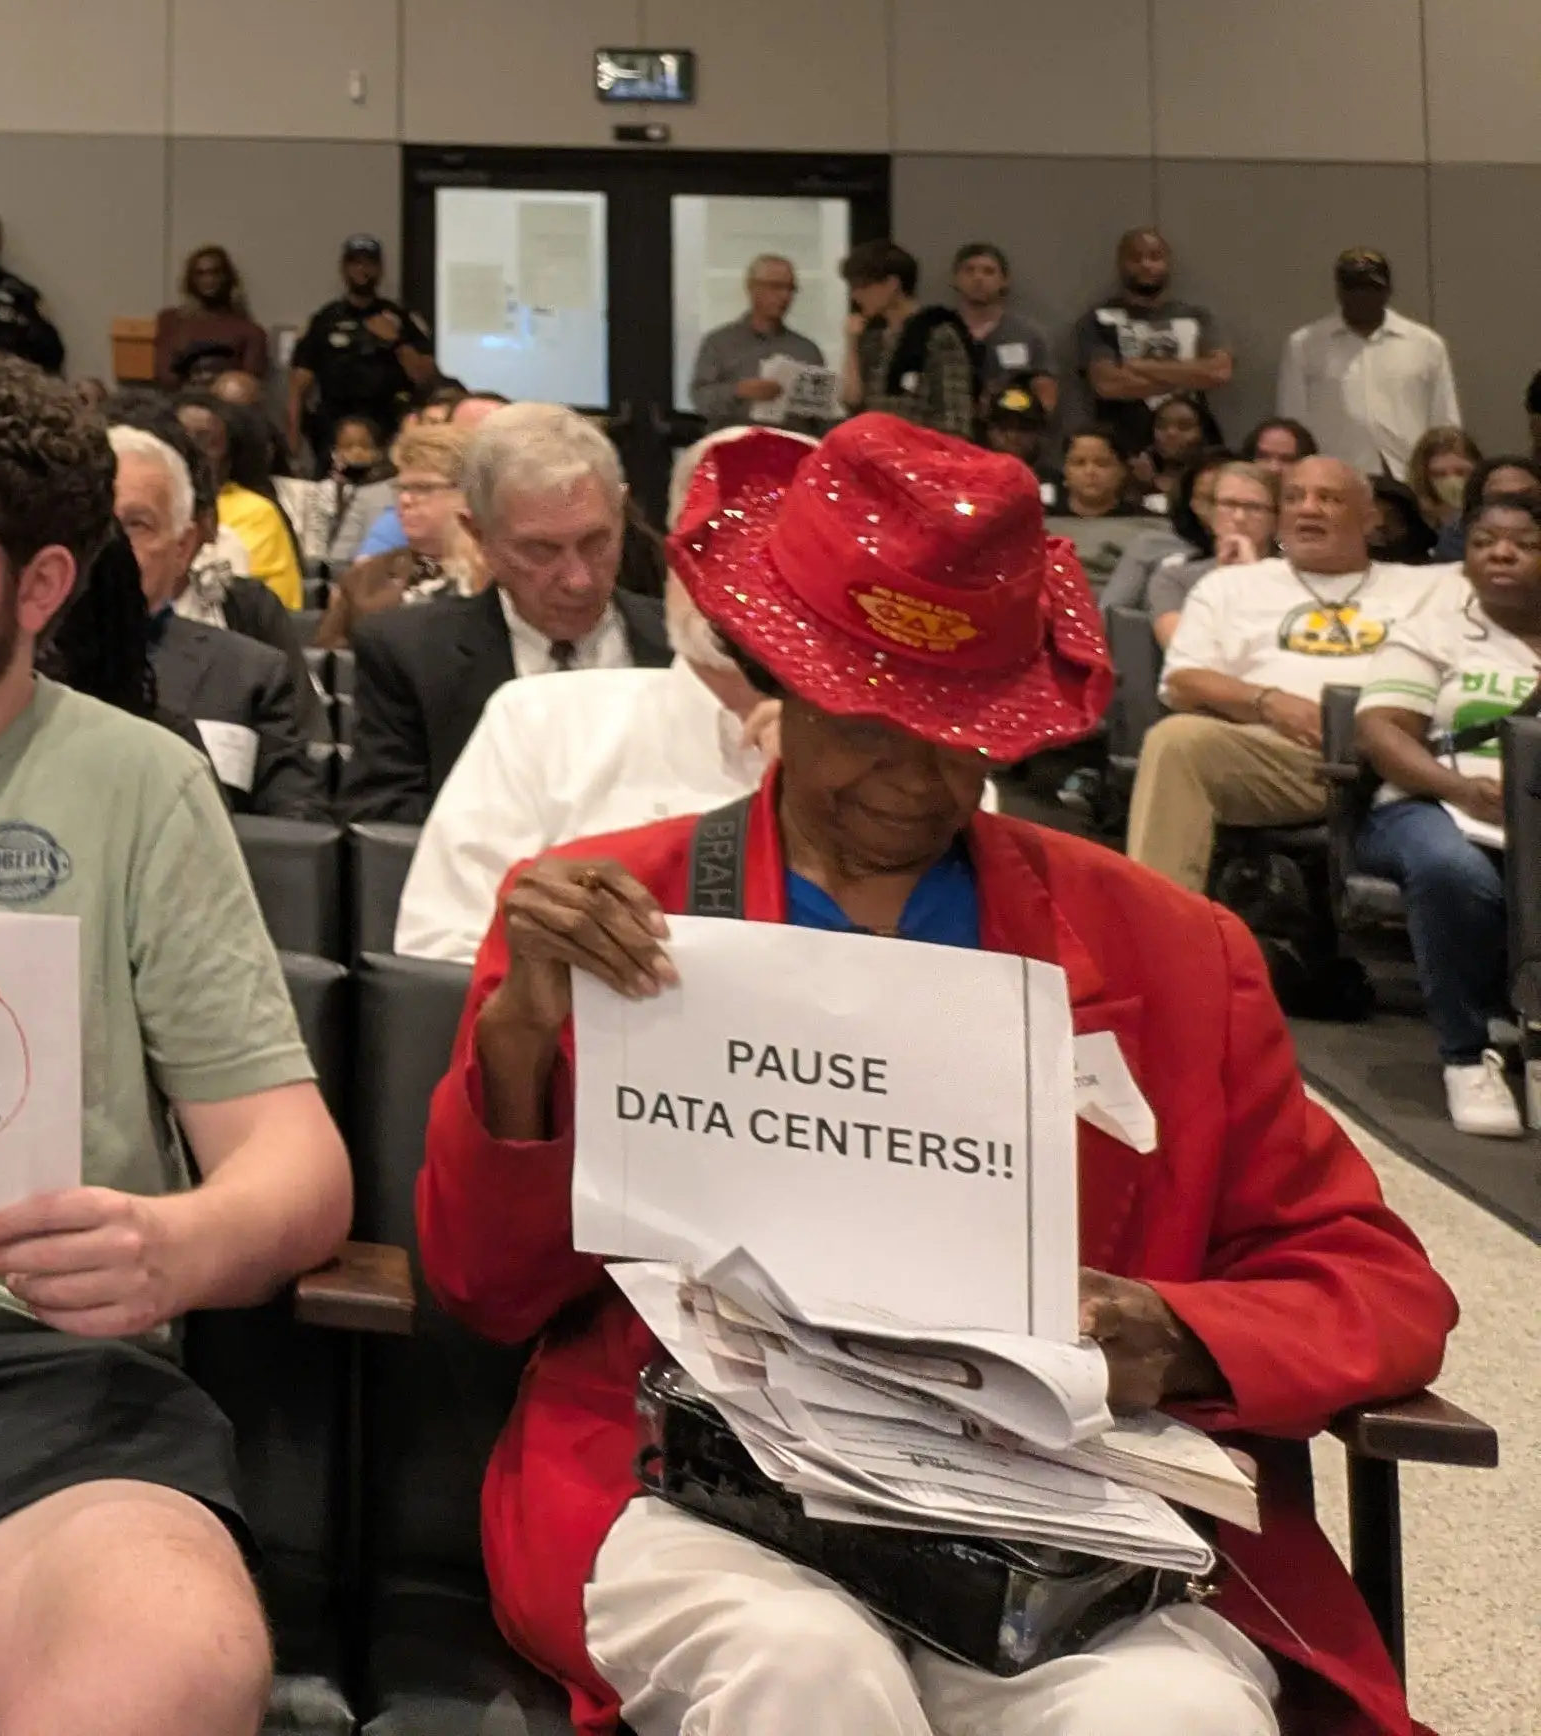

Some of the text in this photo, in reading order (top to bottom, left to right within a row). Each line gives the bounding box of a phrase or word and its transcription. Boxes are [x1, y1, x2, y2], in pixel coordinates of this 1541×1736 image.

[726, 1039, 889, 1095] PAUSE
[616, 1084, 1016, 1180] DATA CENTERS!!
